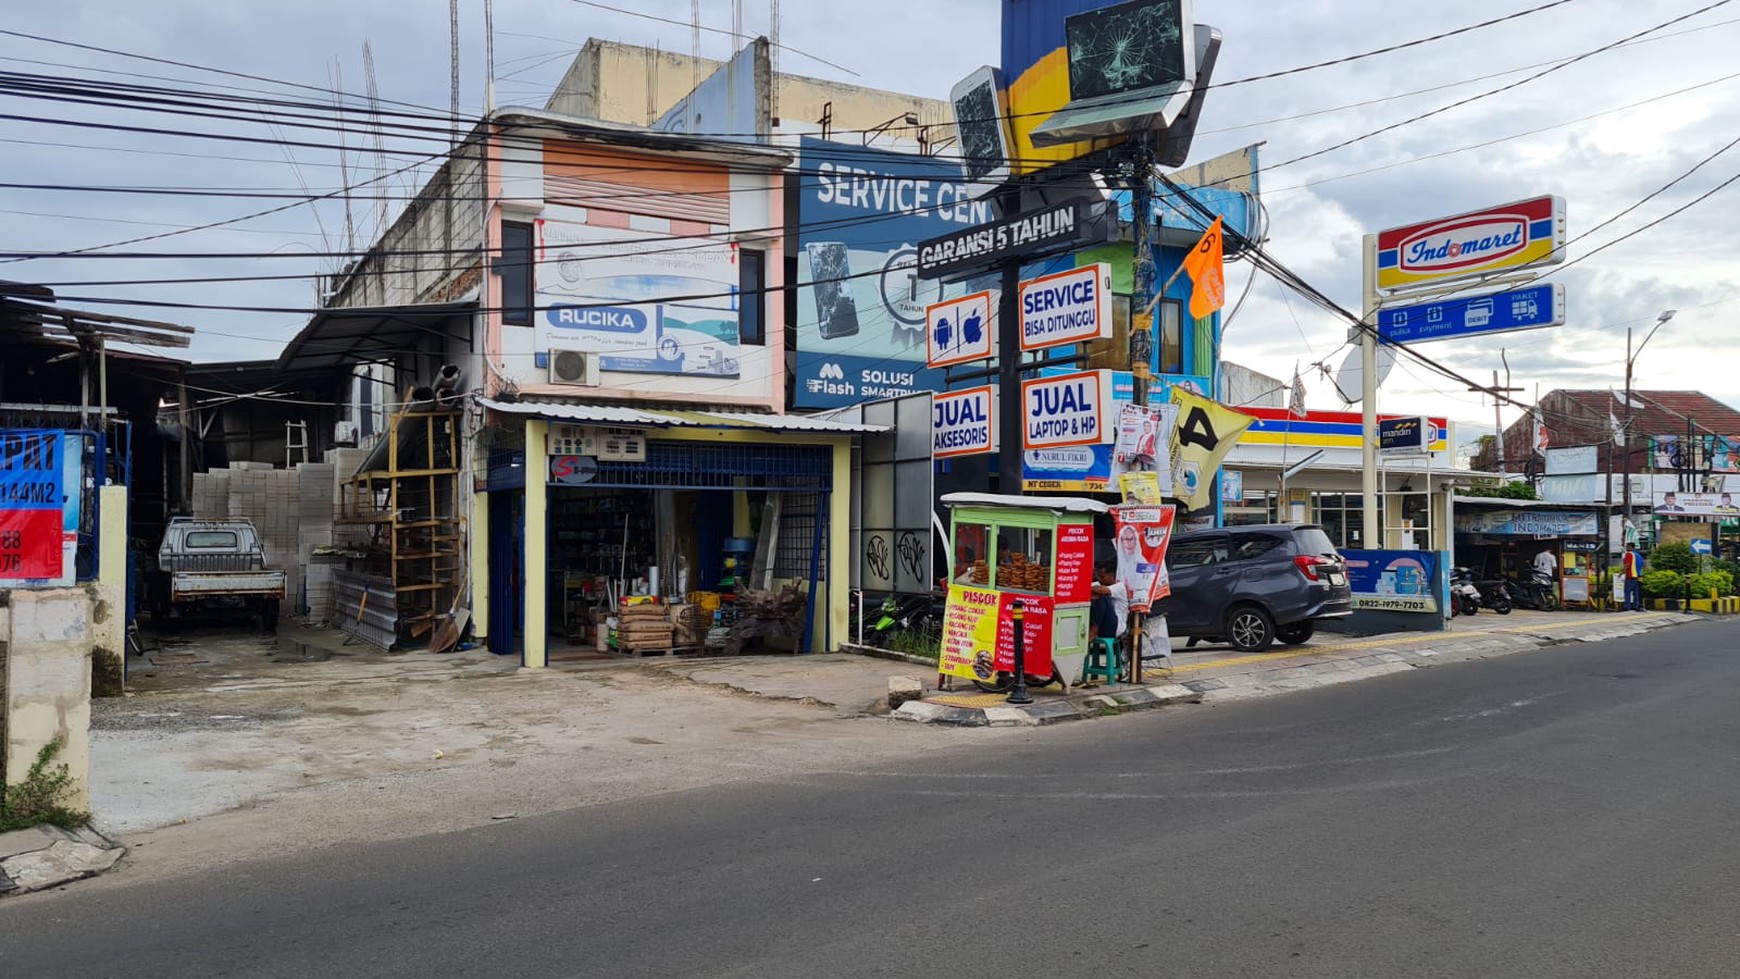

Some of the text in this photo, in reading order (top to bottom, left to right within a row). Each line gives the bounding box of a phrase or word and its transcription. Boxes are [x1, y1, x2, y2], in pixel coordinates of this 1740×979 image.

[817, 162, 930, 218] SERVICE
[921, 206, 1075, 269] GARANSI 5 TAHUN
[1407, 224, 1522, 264] Indomaret
[900, 303, 924, 312] TAHUN
[1024, 280, 1094, 315] SERVICE
[1512, 291, 1538, 300] PAKET
[559, 308, 635, 328] RUCIKA
[1025, 308, 1096, 337] BISA DITUNGGU
[1419, 322, 1453, 334] payment
[1467, 315, 1488, 324] DEBIT
[861, 369, 913, 386] SOLUSI
[934, 396, 987, 429] JUAL
[1032, 383, 1092, 417] JUAL
[934, 426, 988, 450] AKSESORIS
[1030, 416, 1096, 439] LAPTOP & HP
[1178, 406, 1219, 452] 4
[0, 434, 57, 471] PAT
[963, 591, 998, 606] PISCOK
